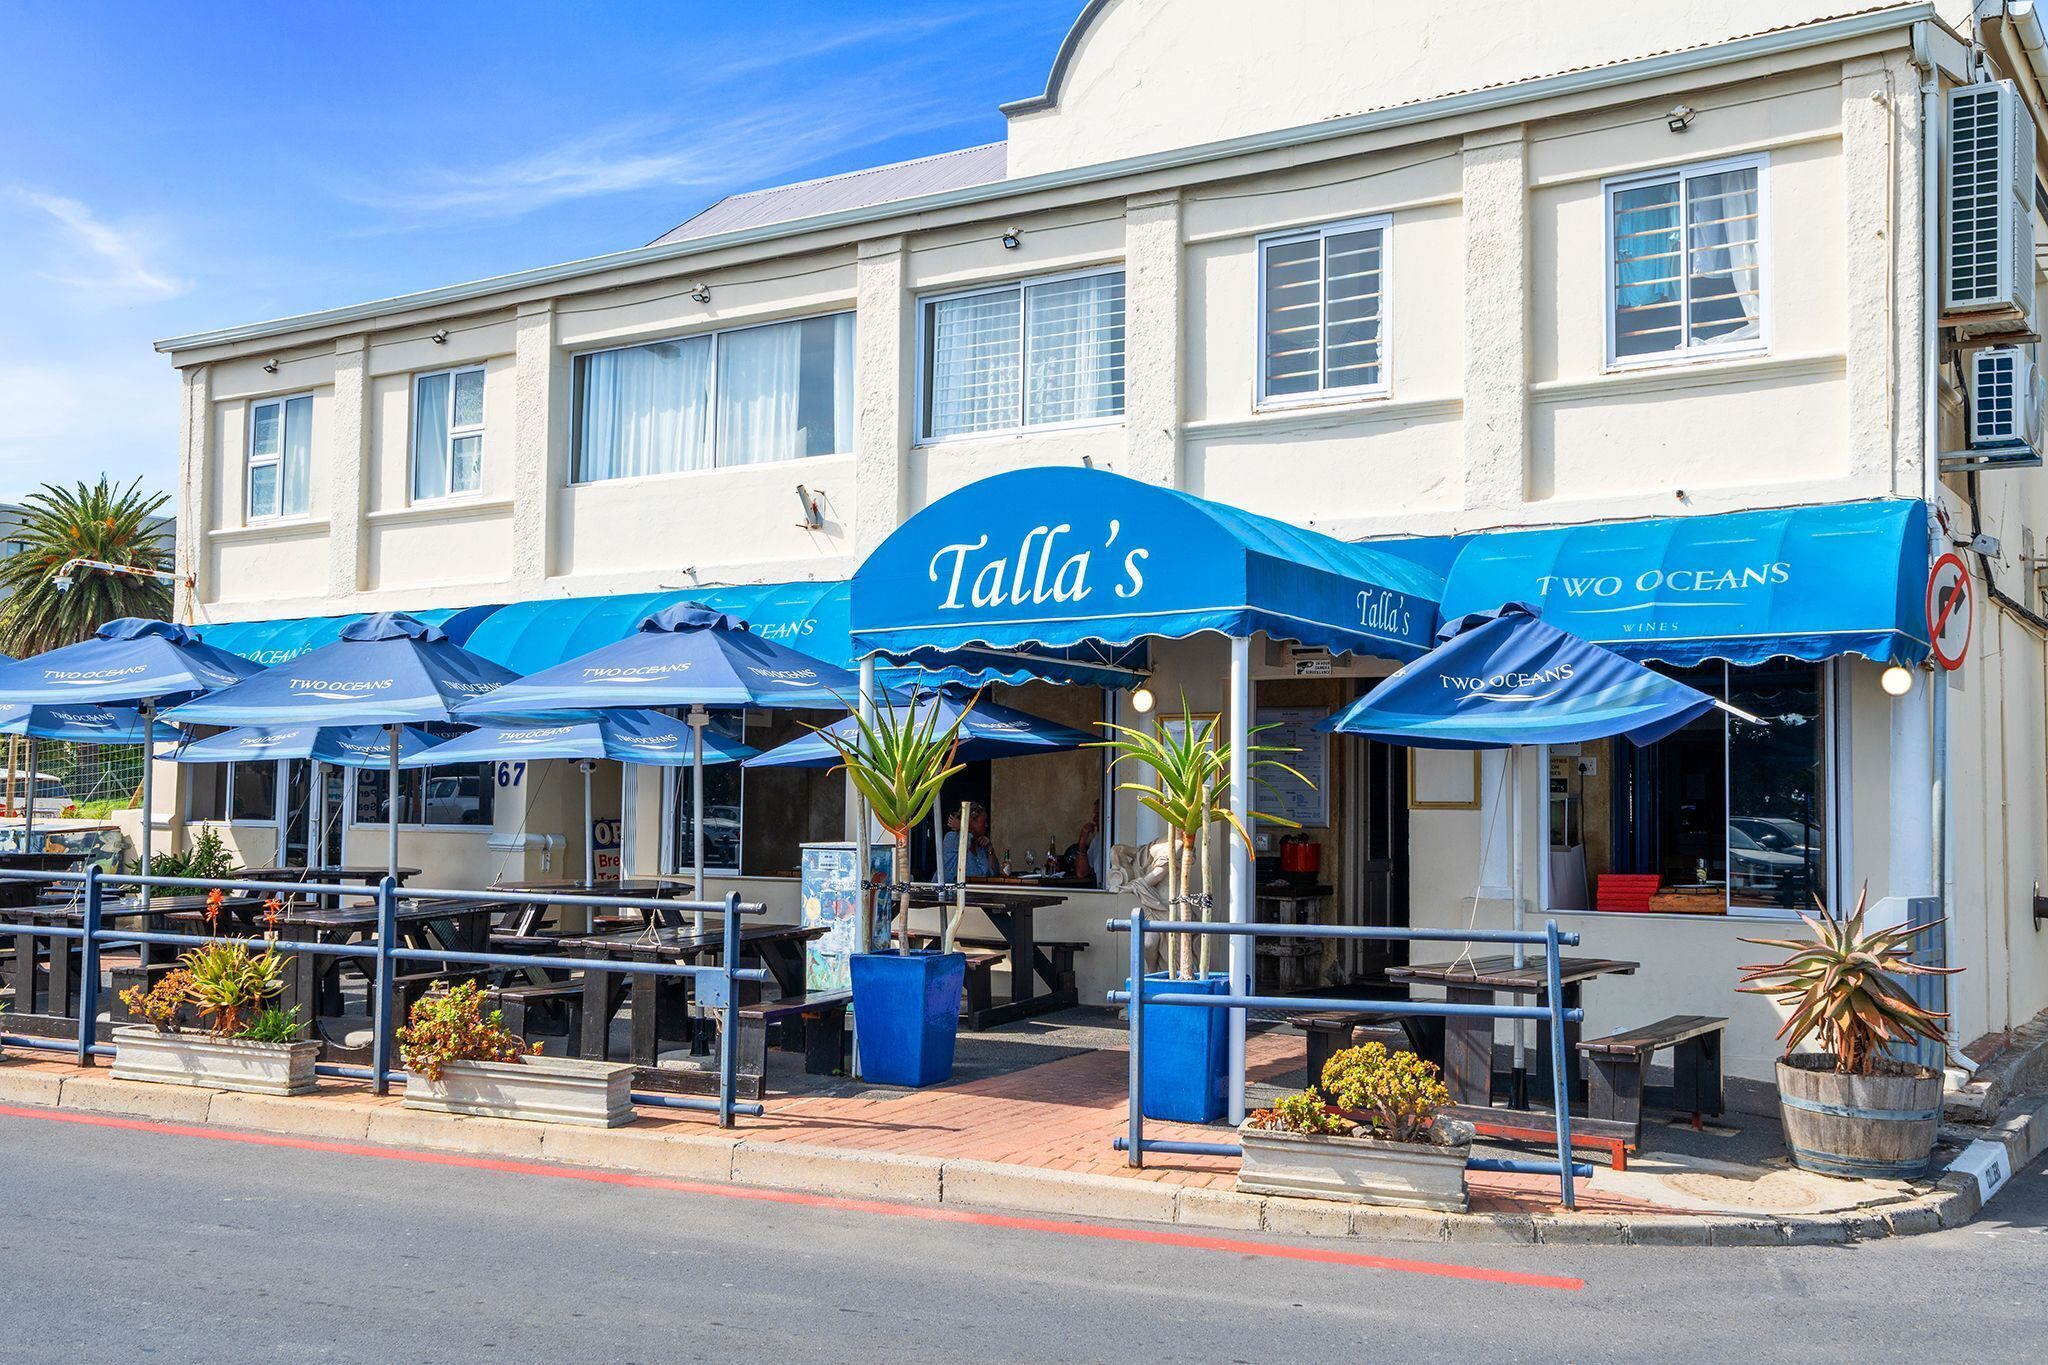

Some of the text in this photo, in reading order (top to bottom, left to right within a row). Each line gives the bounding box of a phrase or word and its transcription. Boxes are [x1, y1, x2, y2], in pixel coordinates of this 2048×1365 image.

[929, 519, 1149, 610] Talla's
[1536, 562, 1792, 598] TWO OCEANS
[1356, 588, 1410, 636] Talla's
[748, 618, 818, 640] CEANS
[1623, 621, 1679, 633] WINES
[44, 664, 148, 679] TWO OCEANS
[582, 662, 692, 677] TWO OCEANS
[1439, 663, 1575, 690] TWO OCEANS
[289, 679, 394, 691] TWO OCEANS
[498, 726, 574, 740] TWO OCEANS
[497, 761, 526, 787] 67
[594, 822, 621, 846] OP
[598, 854, 621, 868] Bre
